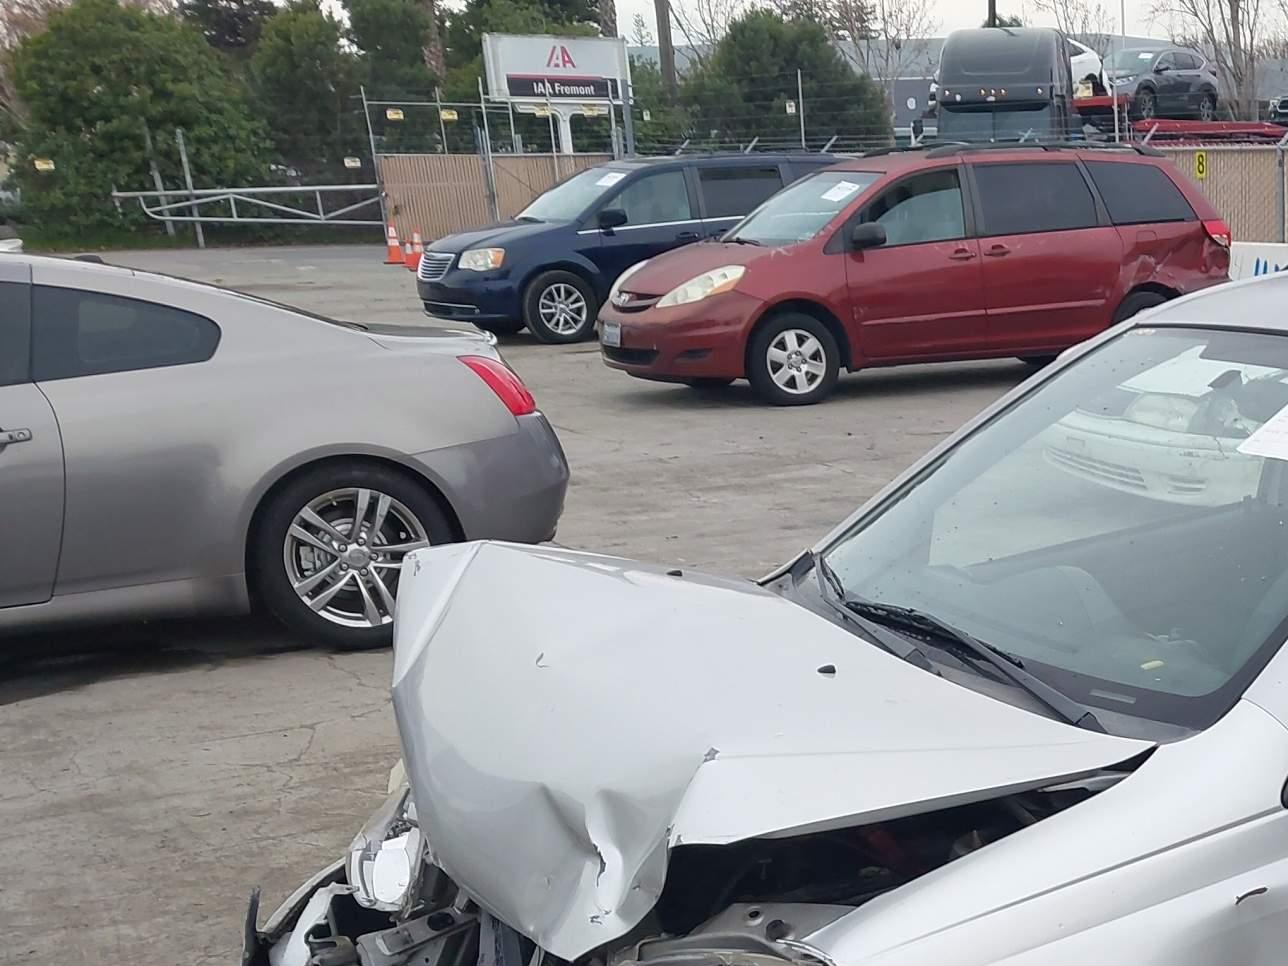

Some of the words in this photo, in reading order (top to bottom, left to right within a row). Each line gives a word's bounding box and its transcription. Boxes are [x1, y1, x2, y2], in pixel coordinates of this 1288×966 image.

[533, 82, 553, 94] IAA
[555, 83, 595, 96] Fremont
[1196, 154, 1206, 175] 8
